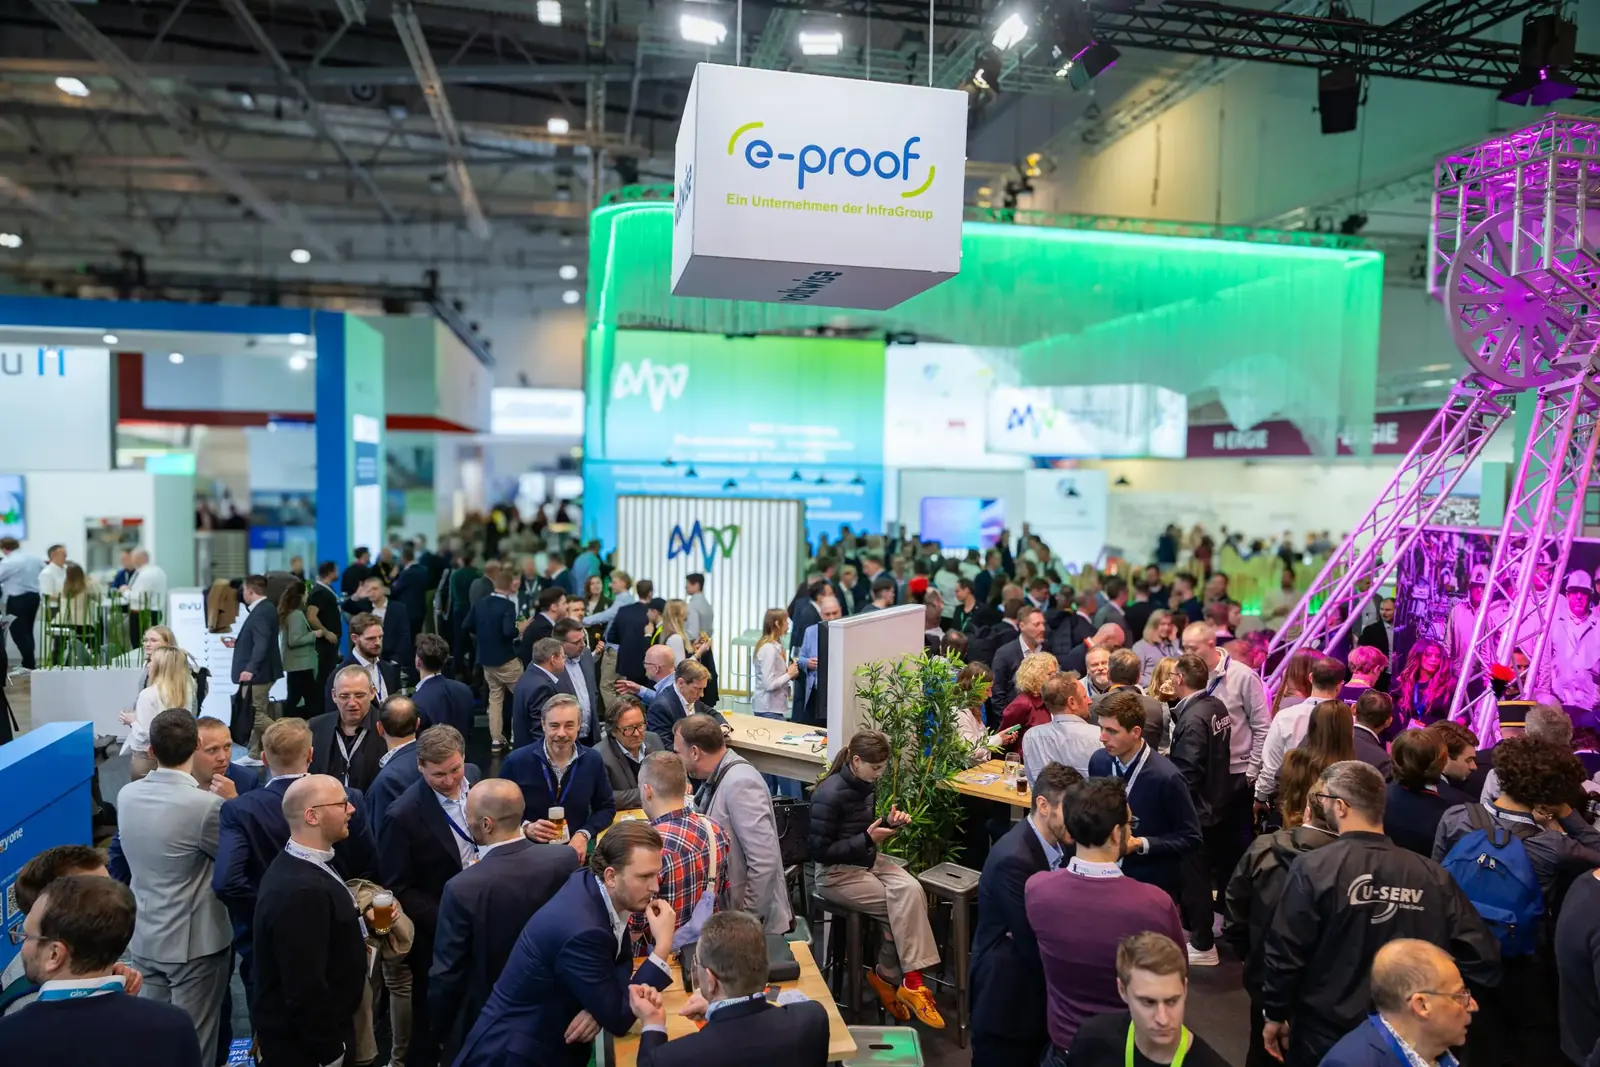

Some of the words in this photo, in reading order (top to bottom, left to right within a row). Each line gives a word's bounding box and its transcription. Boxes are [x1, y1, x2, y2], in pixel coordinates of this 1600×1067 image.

[745, 136, 921, 190] e-proof
[726, 193, 748, 206] Ein
[752, 195, 839, 213] Unternehmen
[842, 202, 863, 215] der
[866, 203, 934, 221] InfraGroup
[1362, 885, 1425, 904] U-SERV
